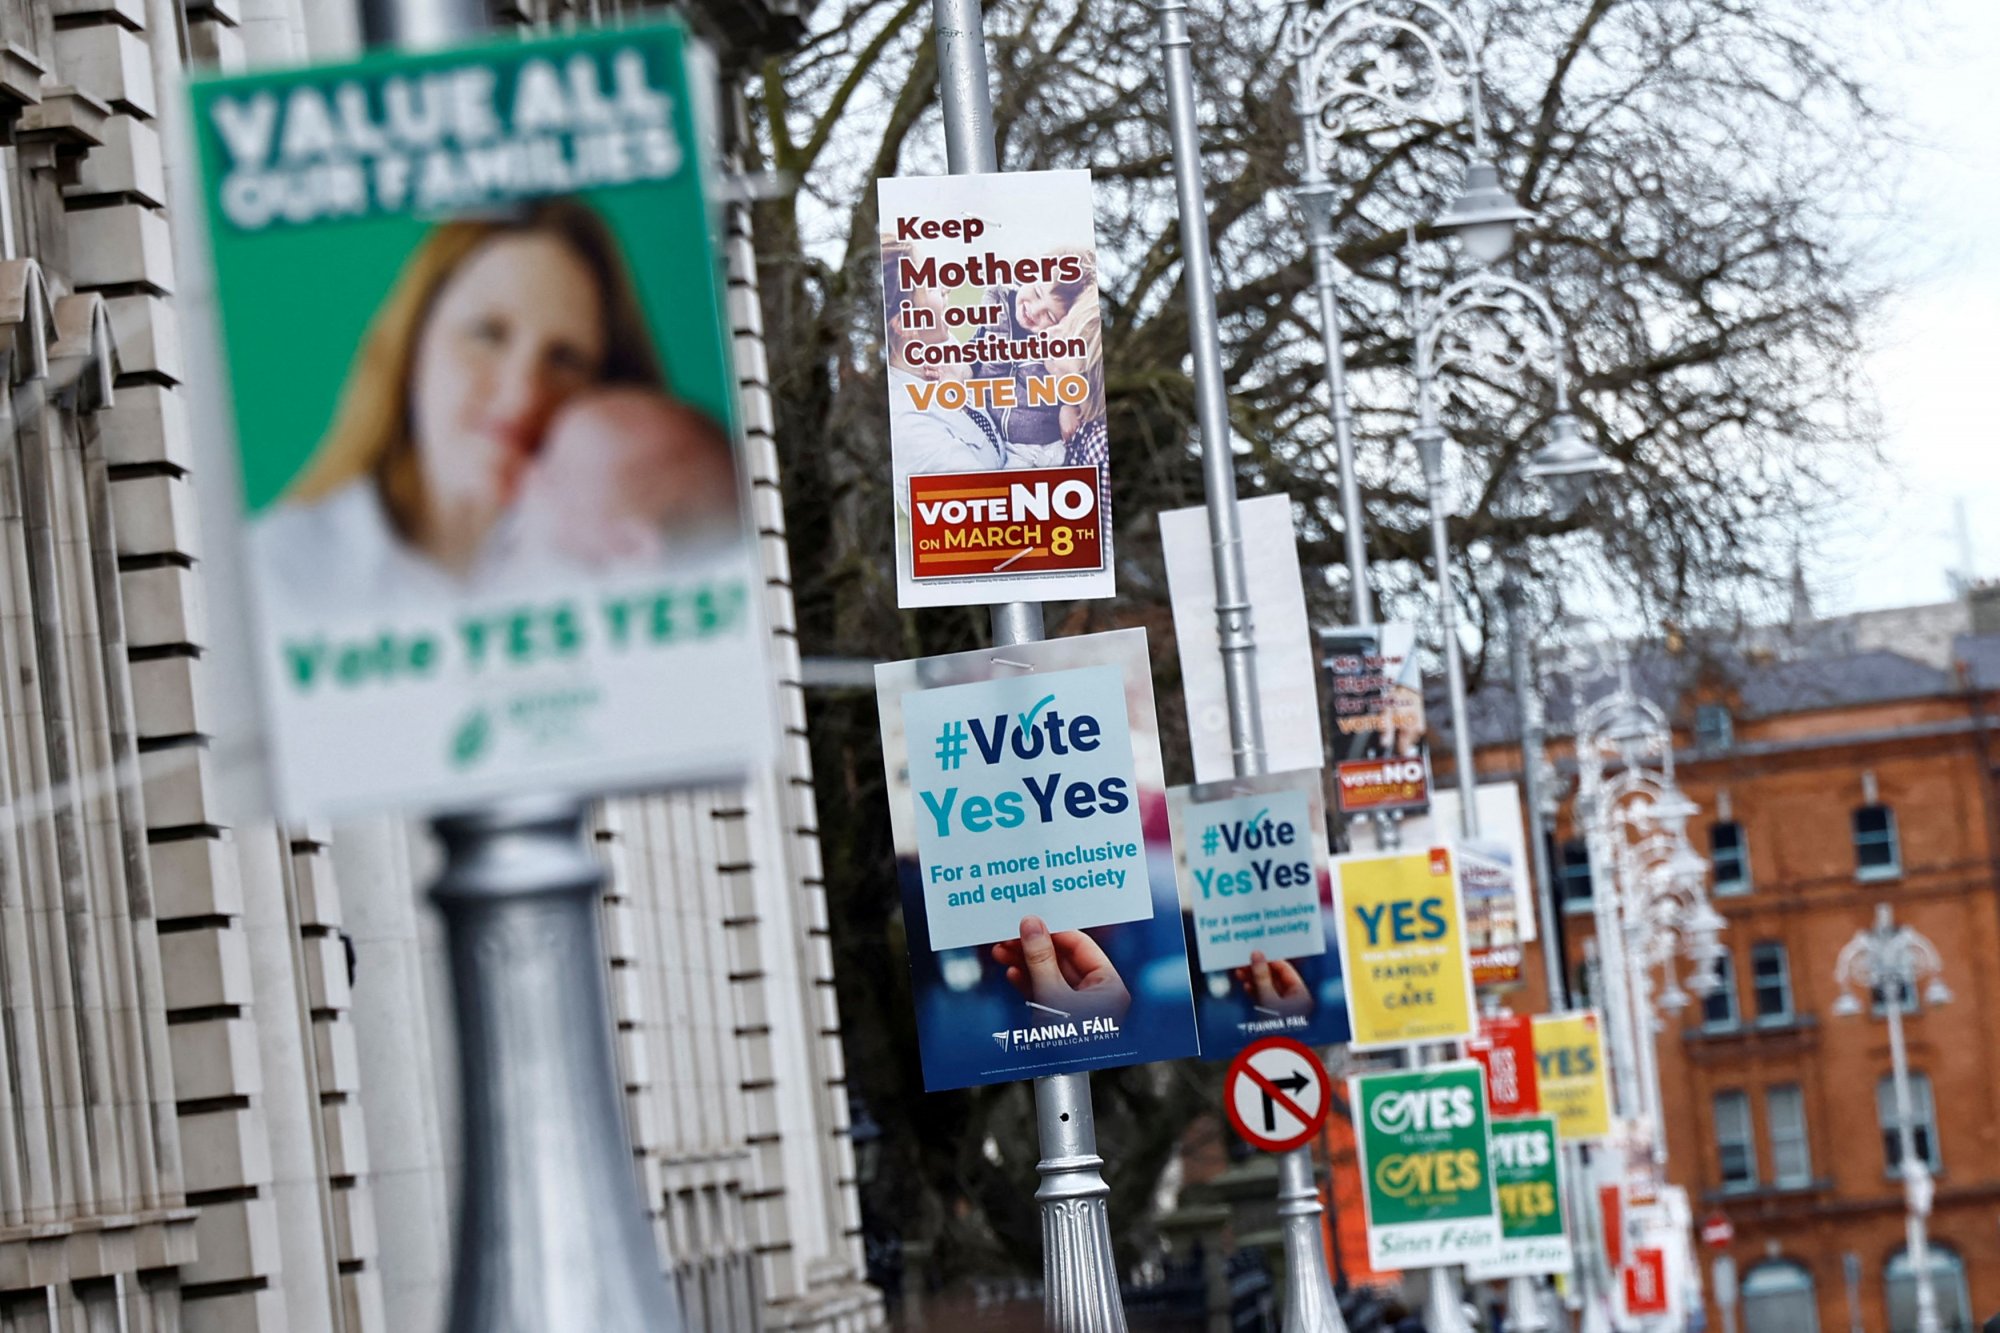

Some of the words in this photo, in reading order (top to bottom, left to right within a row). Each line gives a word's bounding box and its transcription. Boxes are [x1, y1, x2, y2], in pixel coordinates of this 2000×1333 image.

[210, 62, 501, 166] VALUE
[512, 46, 676, 134] ALL
[219, 162, 369, 231] OUR
[375, 124, 684, 209] FAMILIES
[897, 217, 985, 243] Keep
[901, 253, 1081, 289] Mothers
[902, 302, 933, 328] in
[945, 303, 1002, 326] our
[905, 332, 1086, 365] Constitution
[906, 379, 1017, 410] VOTE
[1028, 375, 1089, 405] NO
[916, 498, 1008, 525] VOTE
[1010, 480, 1095, 522] NO
[919, 539, 940, 550] ON
[944, 525, 1042, 549] MARCH
[285, 629, 440, 690] Vote
[457, 605, 584, 667] YES
[935, 708, 1101, 771] #Vote
[1383, 761, 1423, 784] NO
[1201, 817, 1295, 857] #Vote
[931, 865, 964, 884] For
[970, 864, 981, 878] a
[987, 855, 1040, 876] more
[1045, 841, 1137, 869] inclusive
[948, 886, 985, 907] and
[991, 876, 1046, 903] equal
[1052, 868, 1126, 893] society
[1200, 916, 1220, 929] For
[1222, 916, 1230, 926] a
[1231, 910, 1261, 925] more
[1263, 902, 1316, 922] inclusive
[1209, 931, 1232, 944] and
[1234, 924, 1266, 943] equal
[1268, 919, 1311, 938] society
[1355, 897, 1448, 945] YES
[1013, 1022, 1078, 1044] FIANNA
[1083, 1016, 1119, 1035] FÁIL
[1035, 1036, 1090, 1050] REPUBLICAN
[1094, 1032, 1121, 1042] PARTY
[1405, 1085, 1476, 1130] YES
[1409, 1148, 1481, 1194] YES
